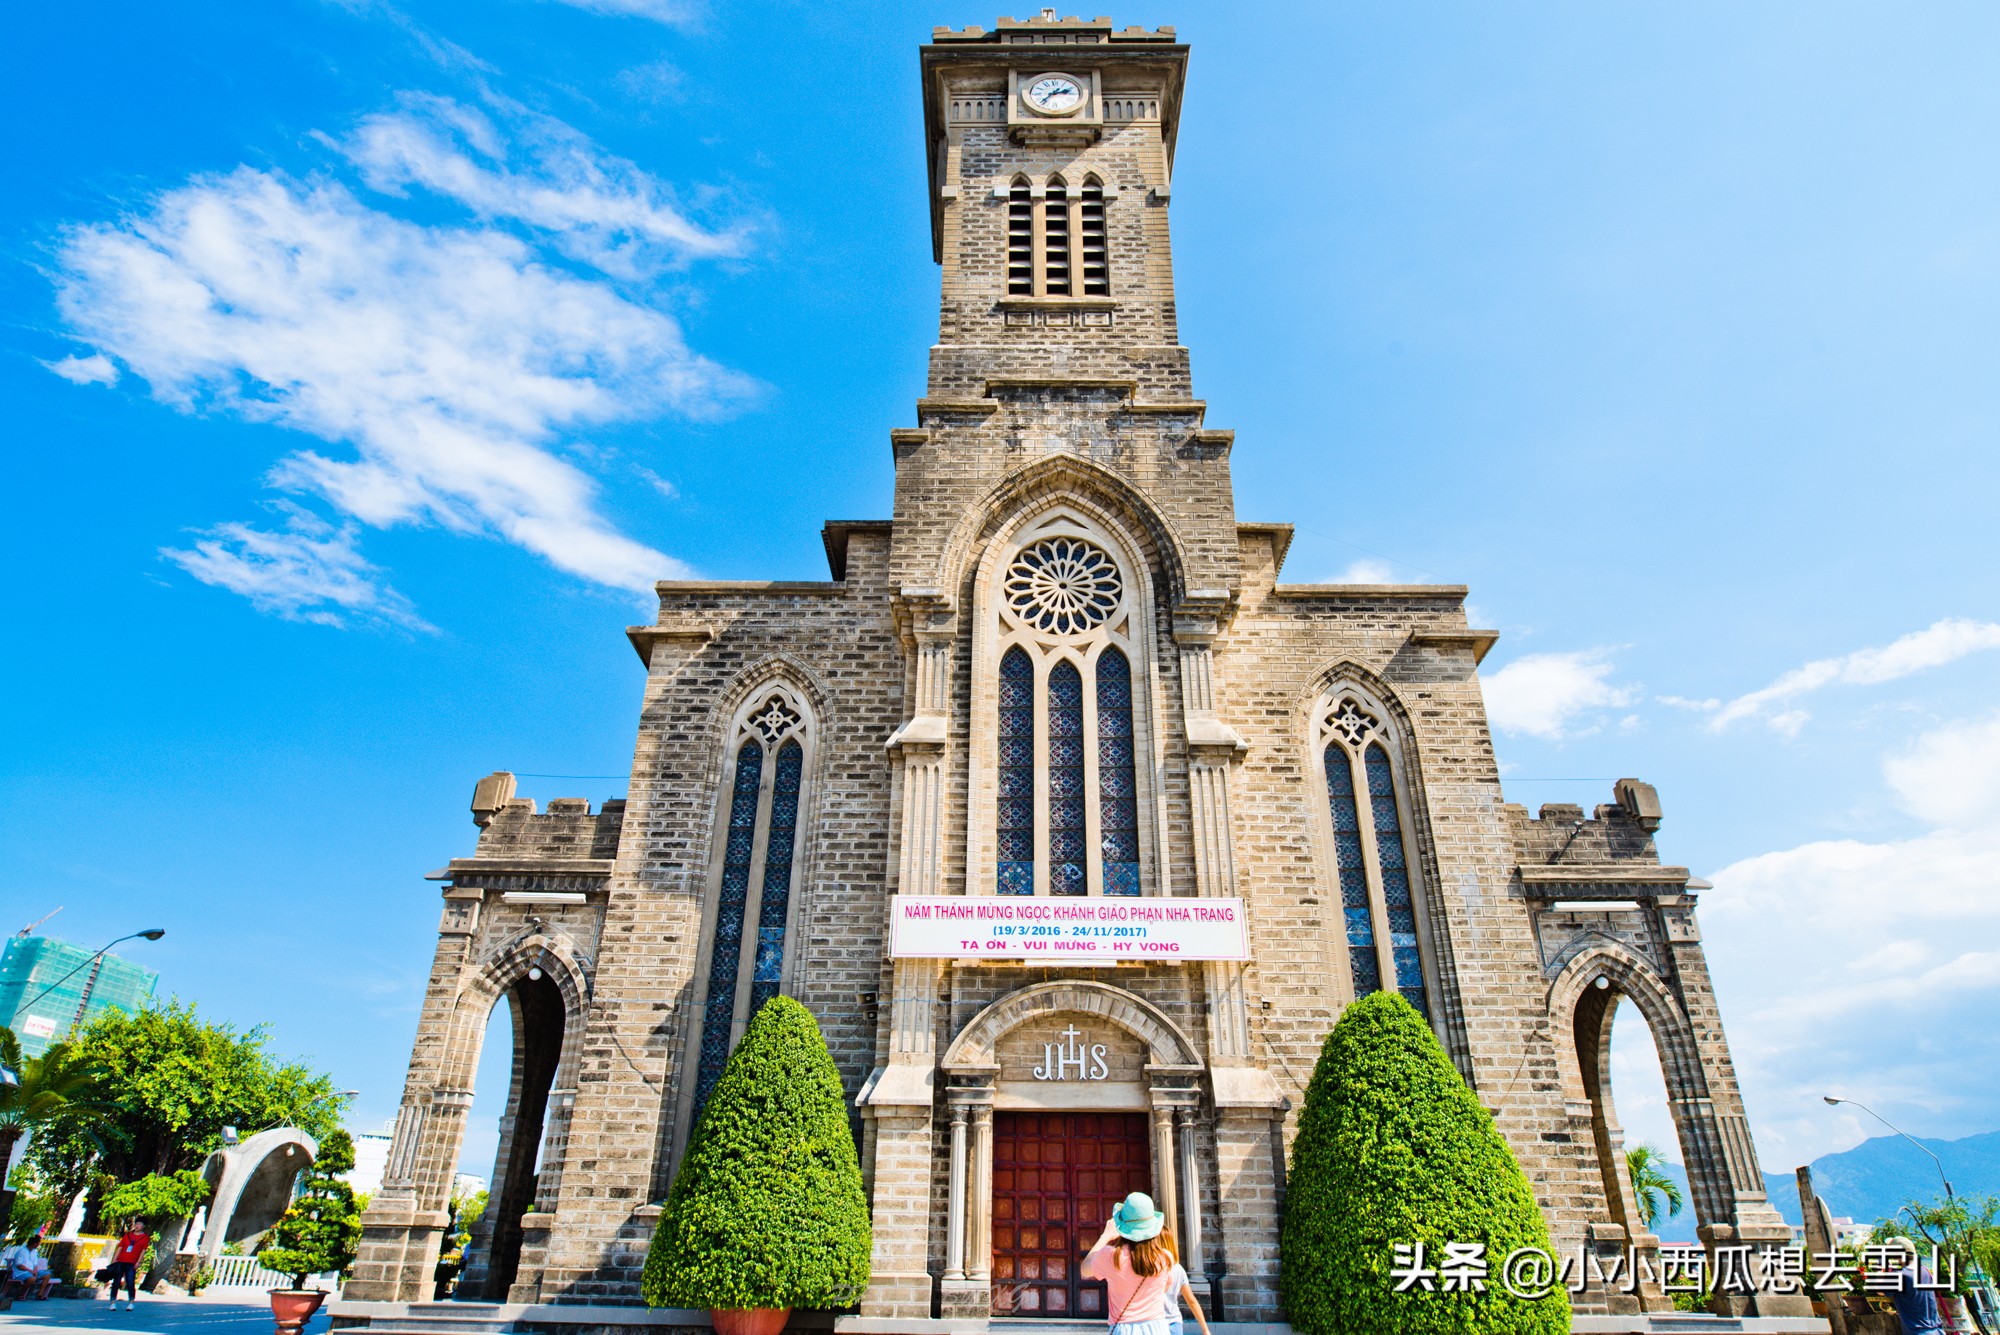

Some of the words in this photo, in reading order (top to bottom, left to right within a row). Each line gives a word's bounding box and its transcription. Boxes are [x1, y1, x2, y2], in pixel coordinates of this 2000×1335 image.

[1016, 905, 1051, 923] NGỌC
[1166, 907, 1191, 921] NHA
[1193, 907, 1235, 922] TRANG
[961, 940, 979, 952] TẠ
[1023, 941, 1048, 950] VUI
[1113, 942, 1133, 951] HY
[1139, 942, 1180, 954] VỌNG
